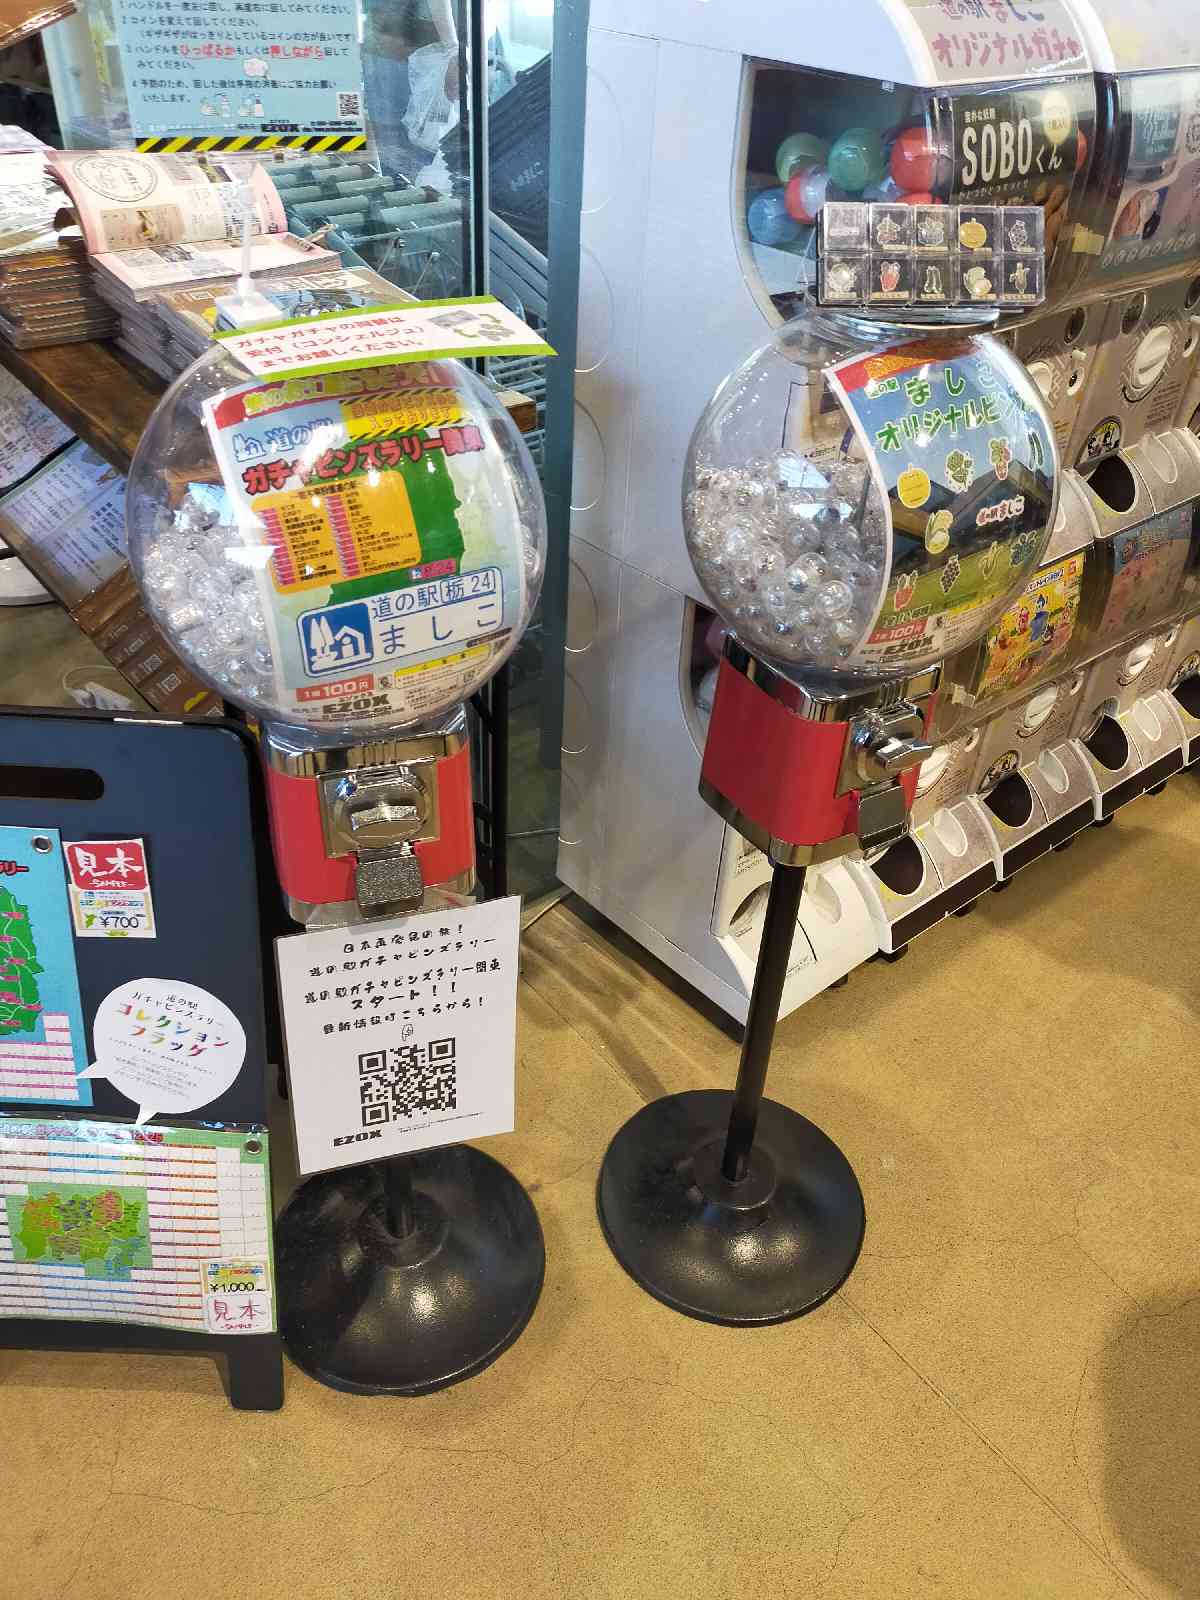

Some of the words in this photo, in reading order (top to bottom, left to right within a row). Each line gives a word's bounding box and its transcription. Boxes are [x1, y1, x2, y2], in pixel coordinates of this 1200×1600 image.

[379, 602, 497, 655] ましこ
[322, 693, 390, 714] EZOX
[74, 847, 143, 879] 見本
[100, 916, 139, 928] ¥700
[333, 1129, 384, 1147] EZOX
[213, 1298, 266, 1322] 見本
